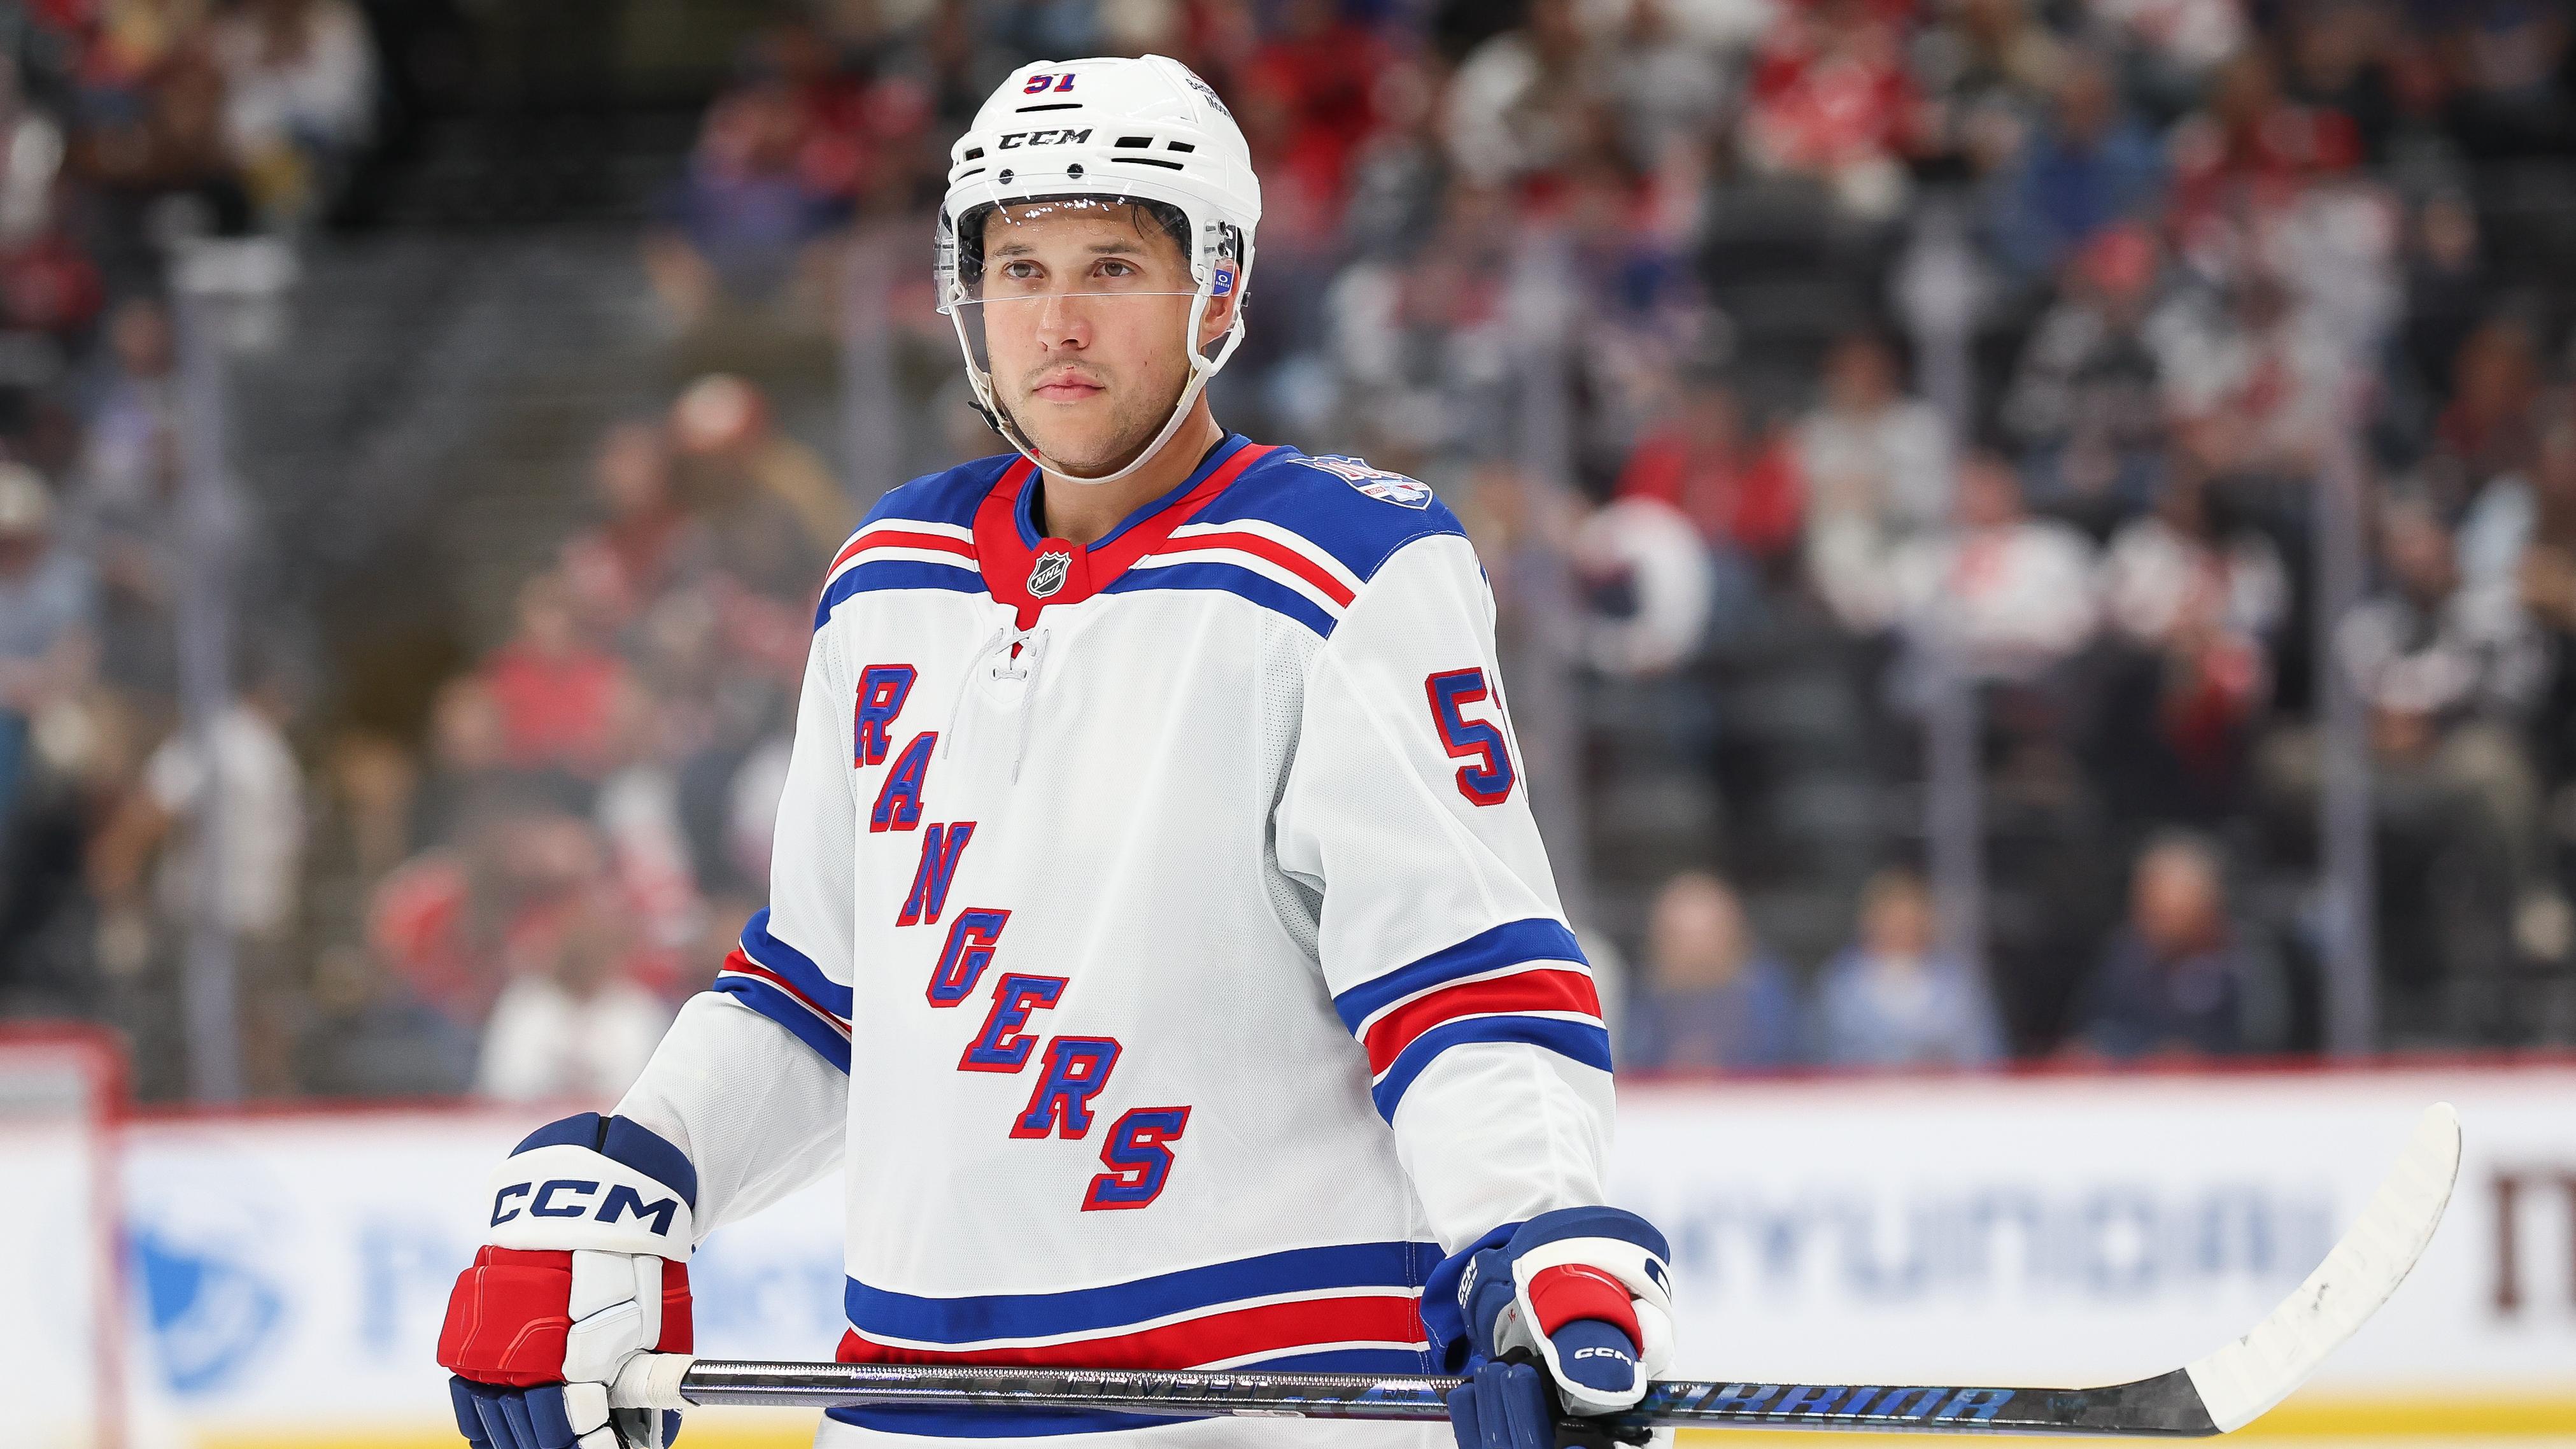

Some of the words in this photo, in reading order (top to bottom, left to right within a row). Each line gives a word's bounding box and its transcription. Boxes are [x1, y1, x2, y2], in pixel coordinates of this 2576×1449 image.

[1023, 73, 1076, 94] 51
[998, 129, 1093, 150] CCM
[1035, 564, 1061, 587] NHL
[1425, 667, 1515, 807] 5
[854, 664, 1192, 1212] RANGERS
[491, 1179, 679, 1237] CCM
[1458, 1254, 1476, 1305] CCM
[1575, 1347, 1631, 1367] CCM
[1644, 1382, 2017, 1422] ARRIOR
